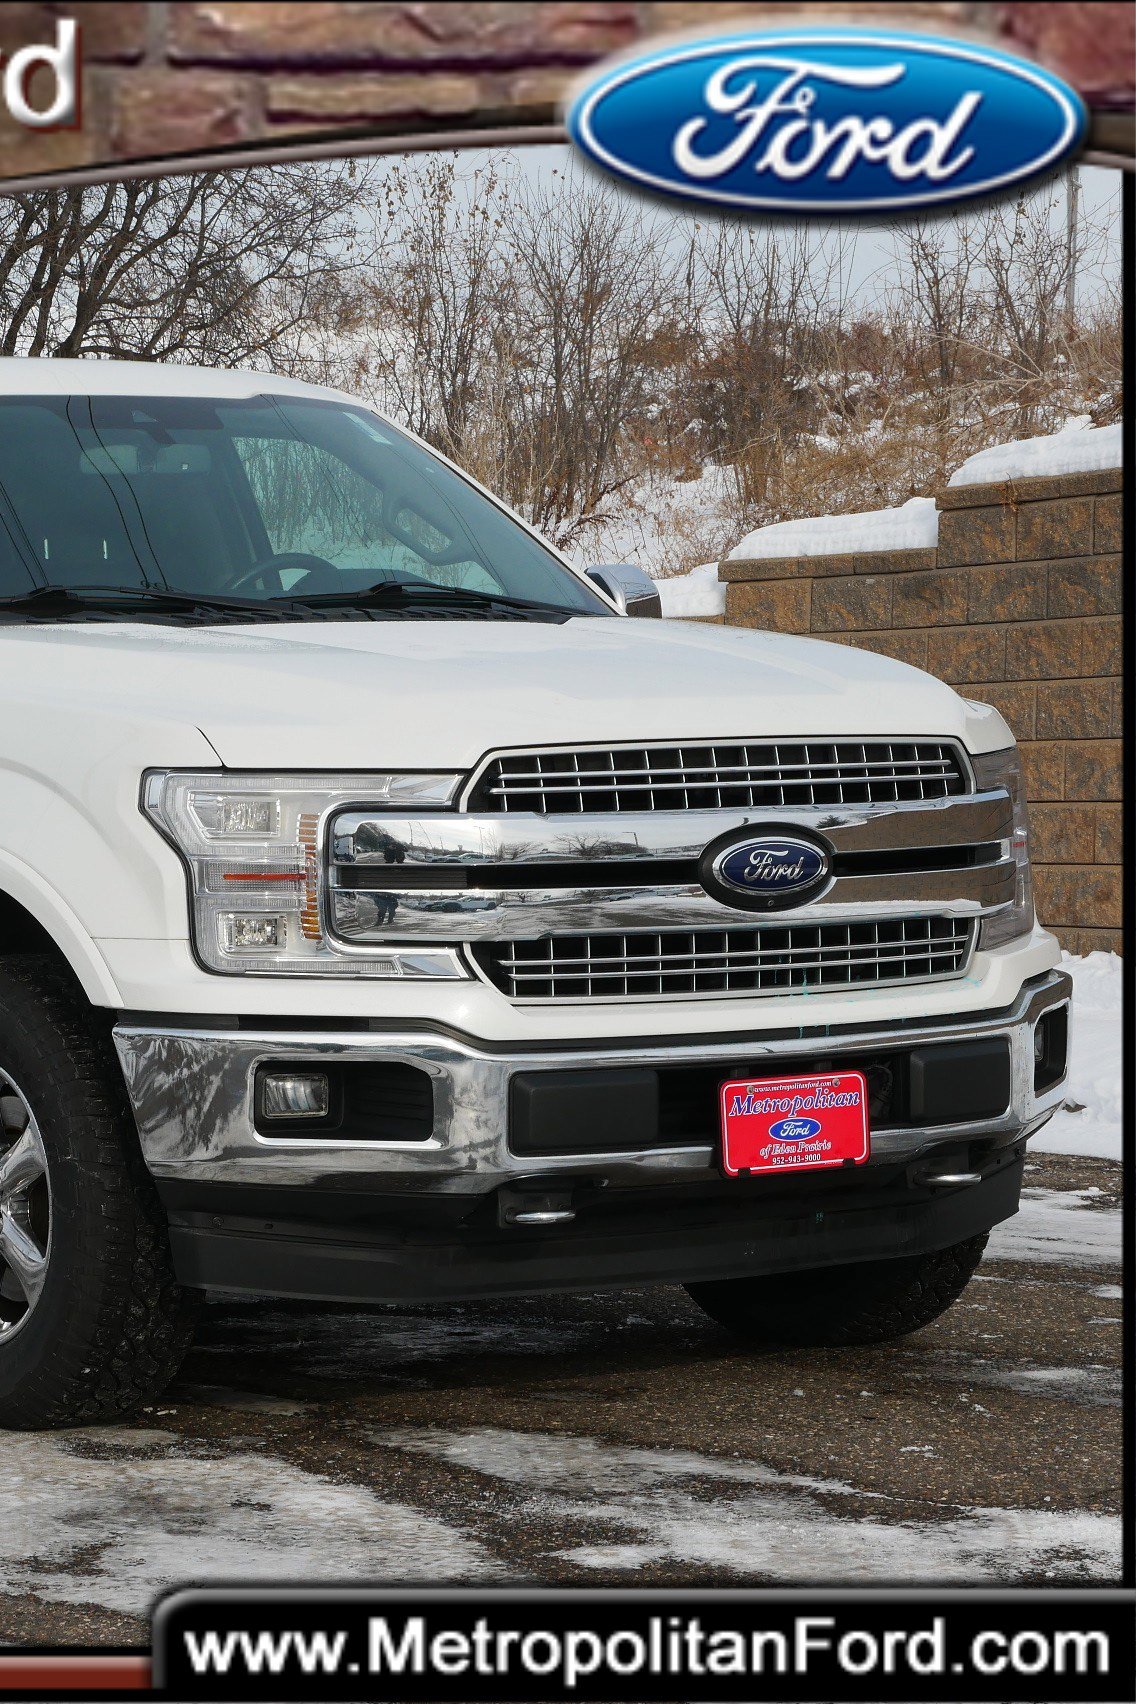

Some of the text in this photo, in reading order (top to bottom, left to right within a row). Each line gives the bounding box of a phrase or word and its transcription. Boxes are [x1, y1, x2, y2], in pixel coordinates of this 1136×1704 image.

[743, 849, 805, 882] Ford
[729, 1088, 860, 1117] Metropolitan
[780, 1121, 810, 1137] Ford
[760, 1139, 832, 1159] of Eden Prairie
[772, 1153, 821, 1165] 952-943-9000
